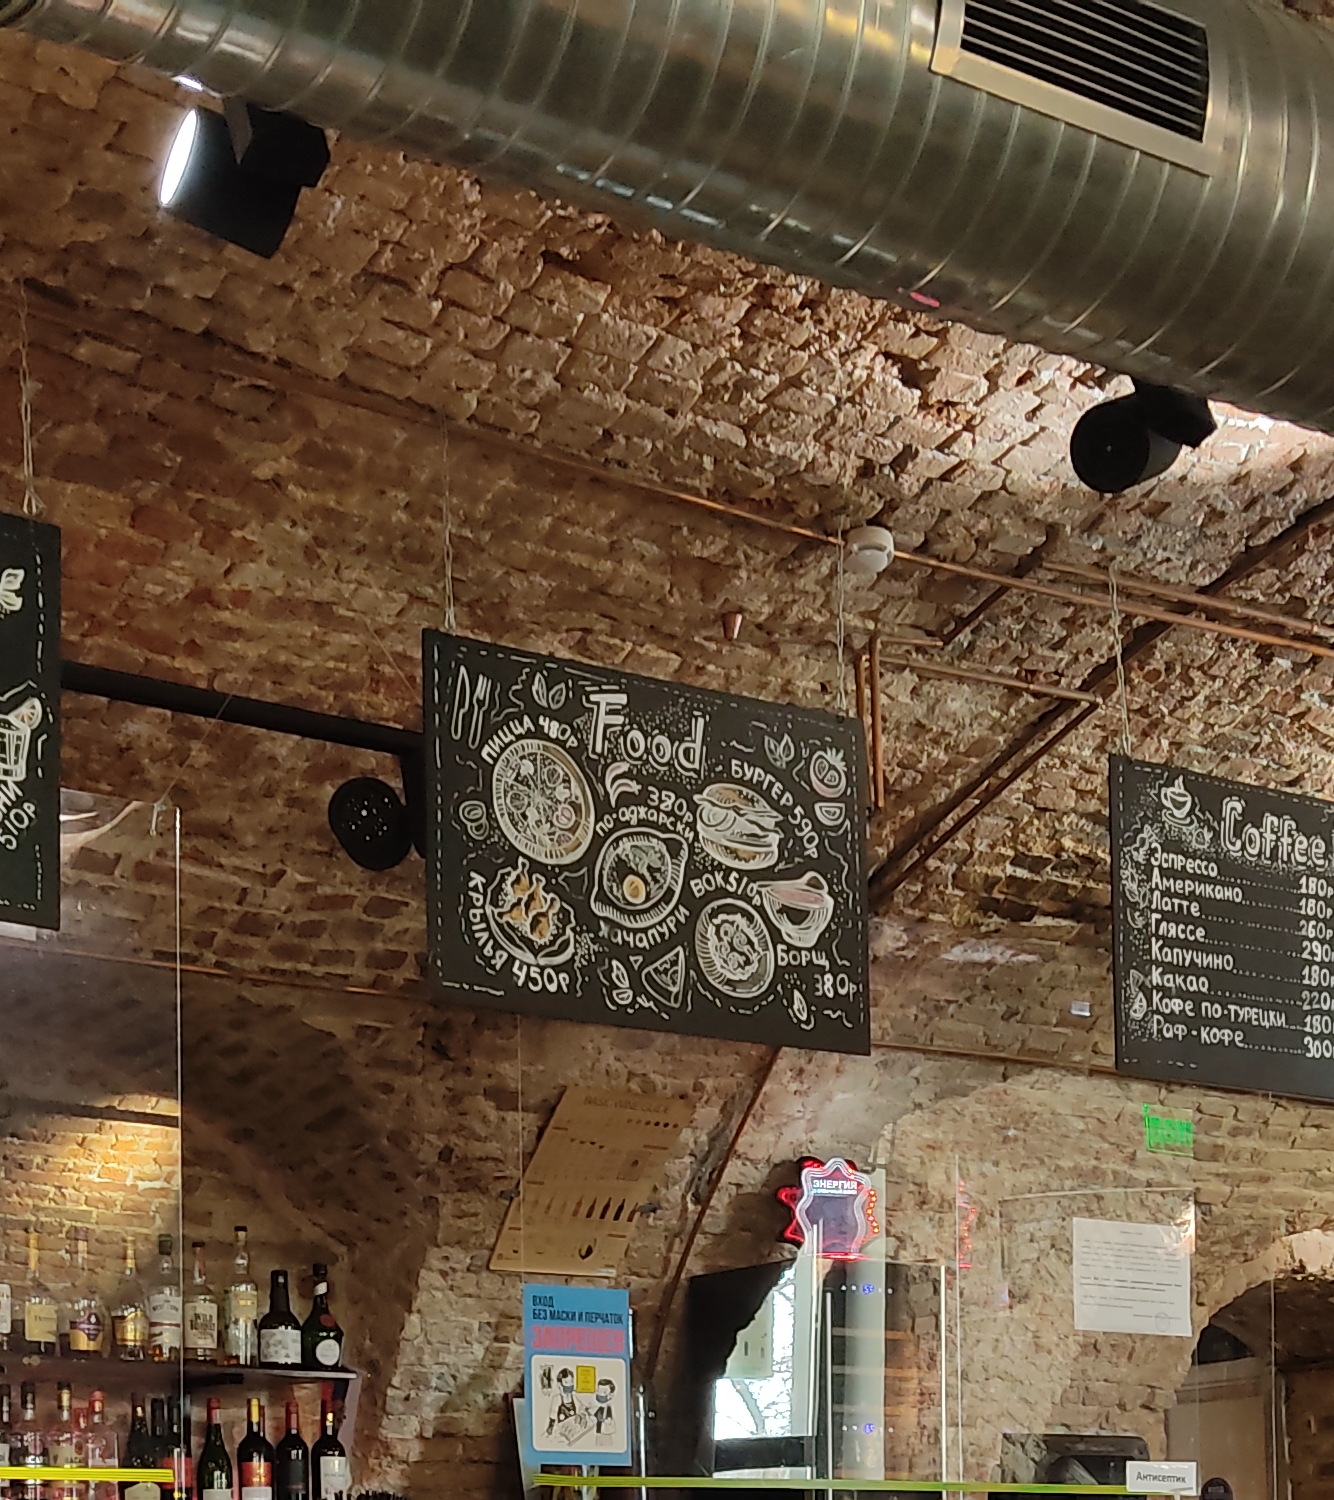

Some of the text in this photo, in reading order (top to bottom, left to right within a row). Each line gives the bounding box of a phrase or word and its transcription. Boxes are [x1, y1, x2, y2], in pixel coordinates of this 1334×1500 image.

[480, 714, 536, 765] ПИЦЦА
[589, 692, 705, 771] Food
[730, 758, 794, 807] БУРГЕР
[1225, 800, 1326, 866] Coffee
[1150, 842, 1218, 878] Эспрессо
[1151, 866, 1243, 903] Американо
[1151, 889, 1201, 917] Латте
[1151, 912, 1206, 942] Гляссе
[1151, 936, 1234, 972] Капучино
[1151, 964, 1209, 994] Какао
[1152, 989, 1196, 1017] Кофе
[812, 1179, 858, 1190] ЭНЕРГИЯ
[532, 1294, 555, 1309] ВХОД
[532, 1308, 624, 1325] БЕЗ МАСКИ И ПЕРЧАТОК
[1136, 1471, 1187, 1484] Антисептик
